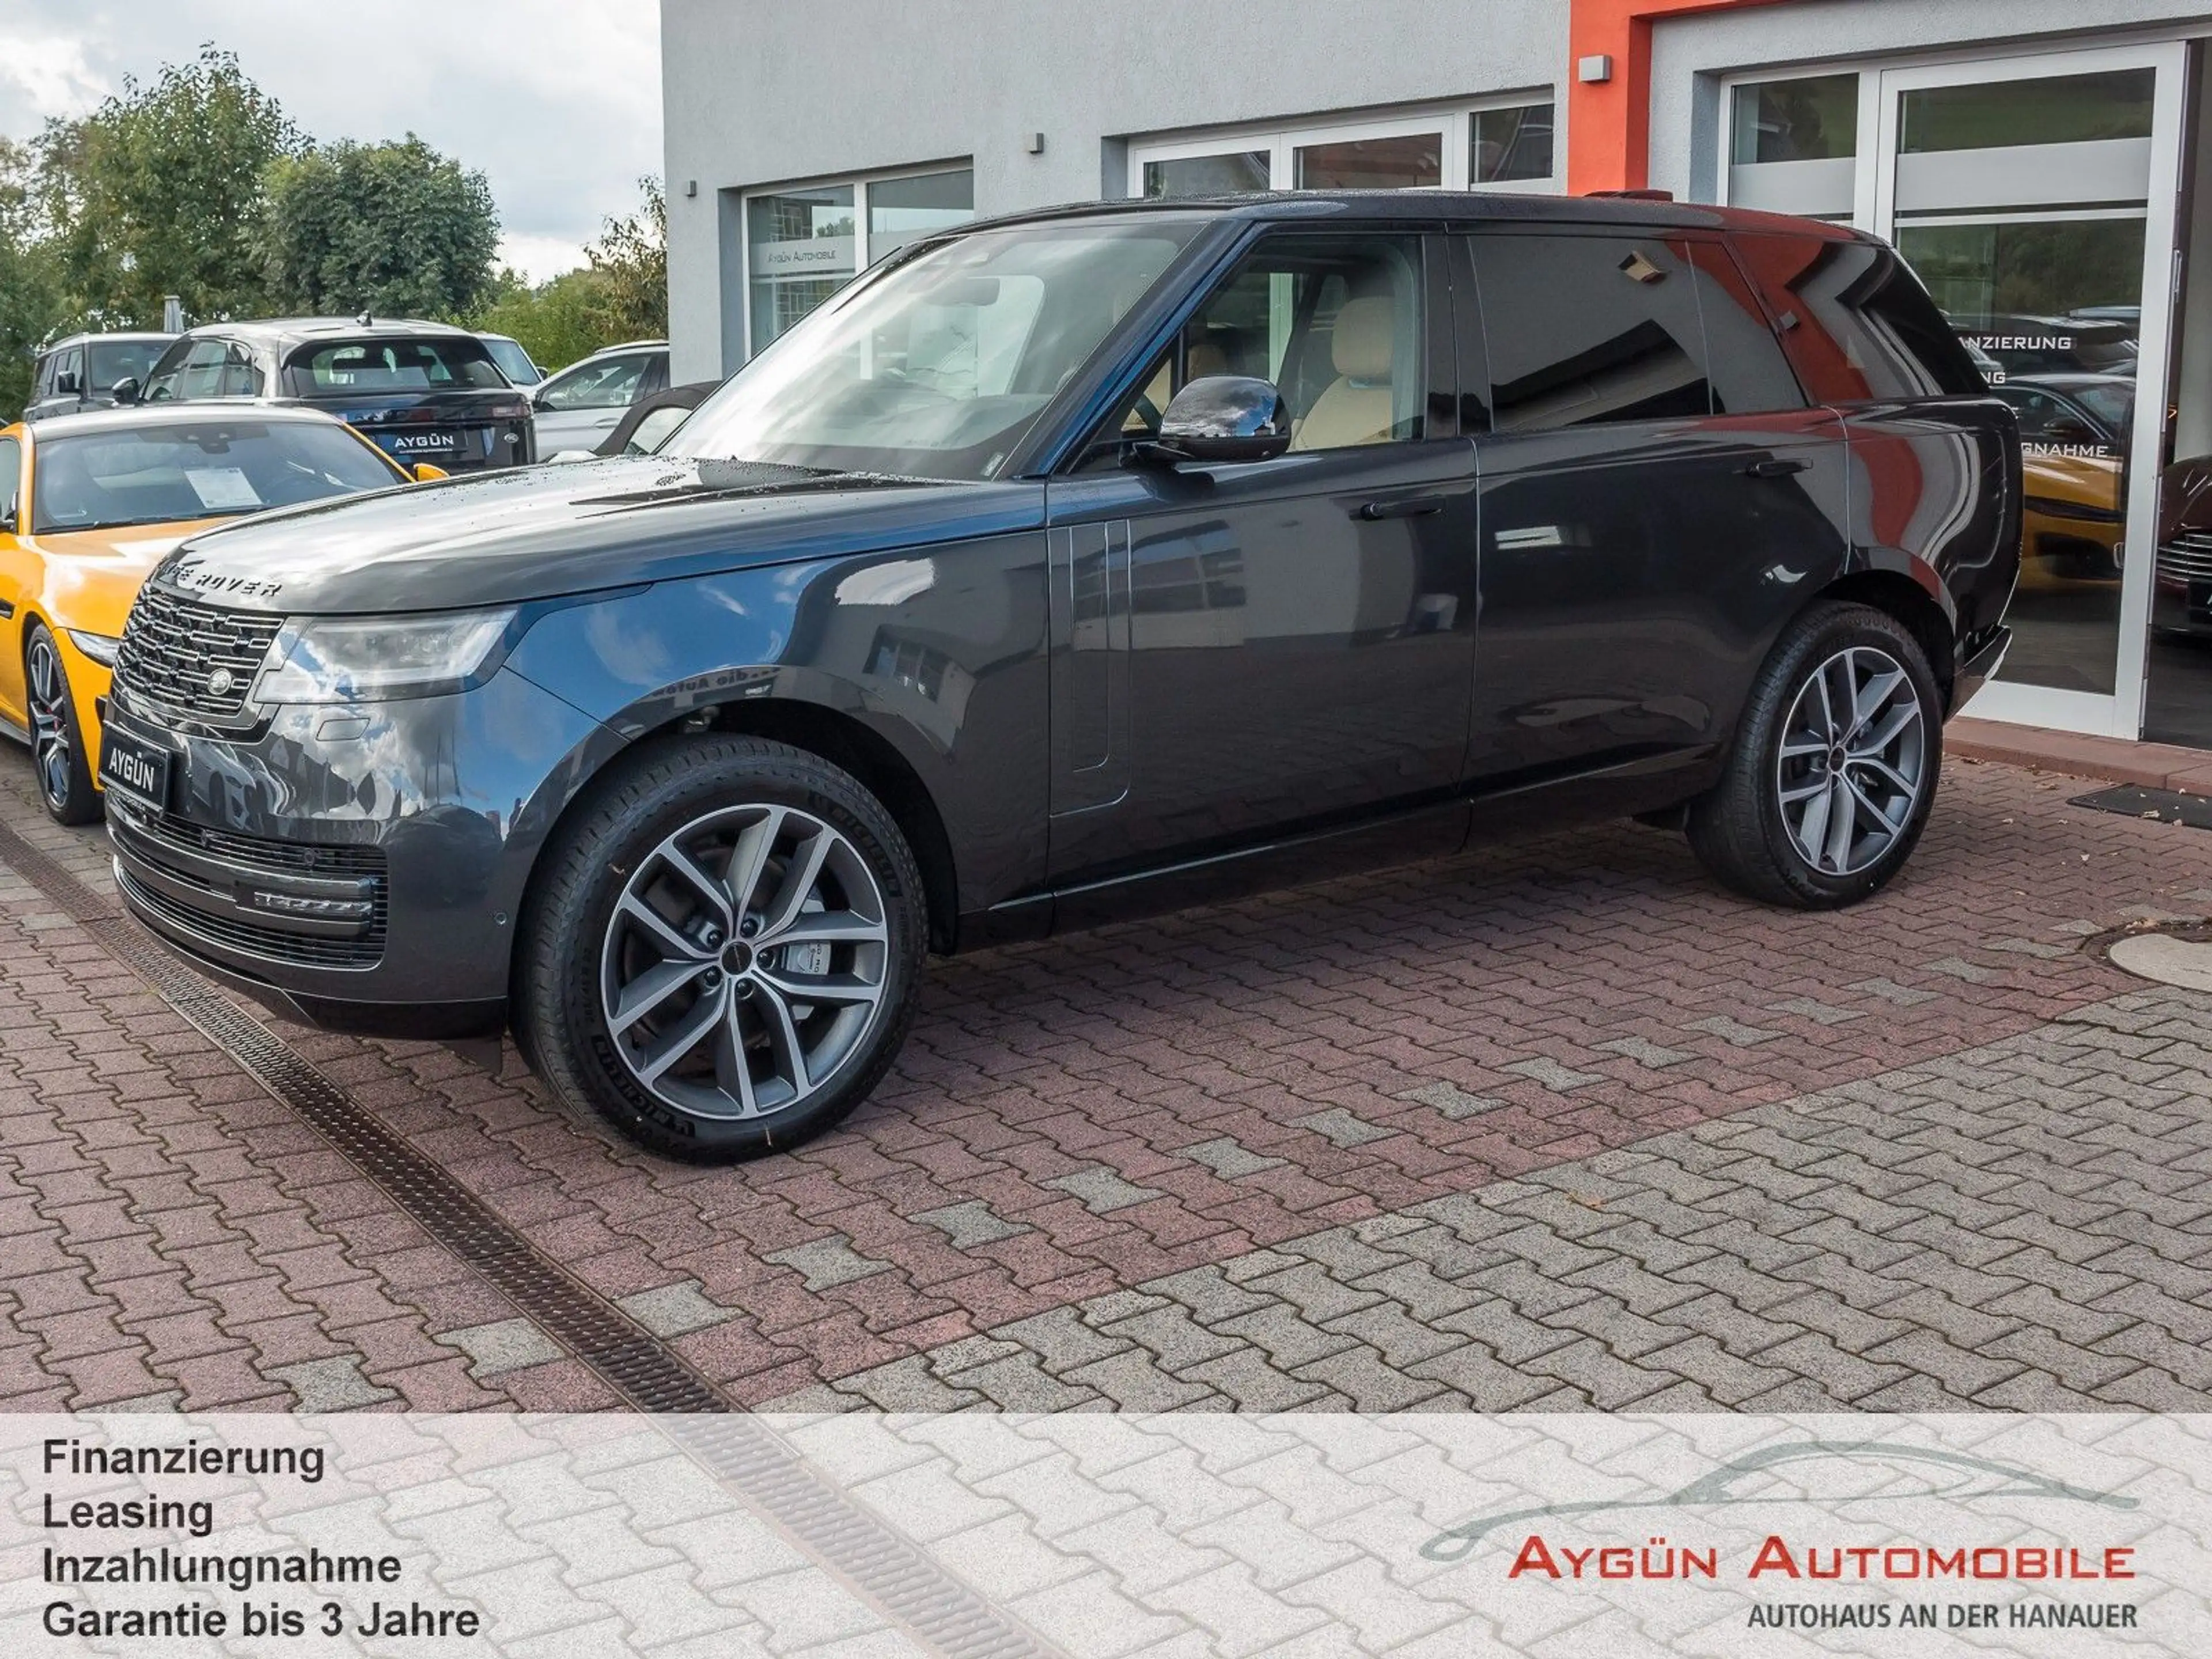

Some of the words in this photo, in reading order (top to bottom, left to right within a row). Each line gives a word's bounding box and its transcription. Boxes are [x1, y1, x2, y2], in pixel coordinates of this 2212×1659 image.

[395, 433, 454, 448] AYGÜN
[196, 574, 282, 597] ROVER
[109, 748, 154, 793] AYGÜN
